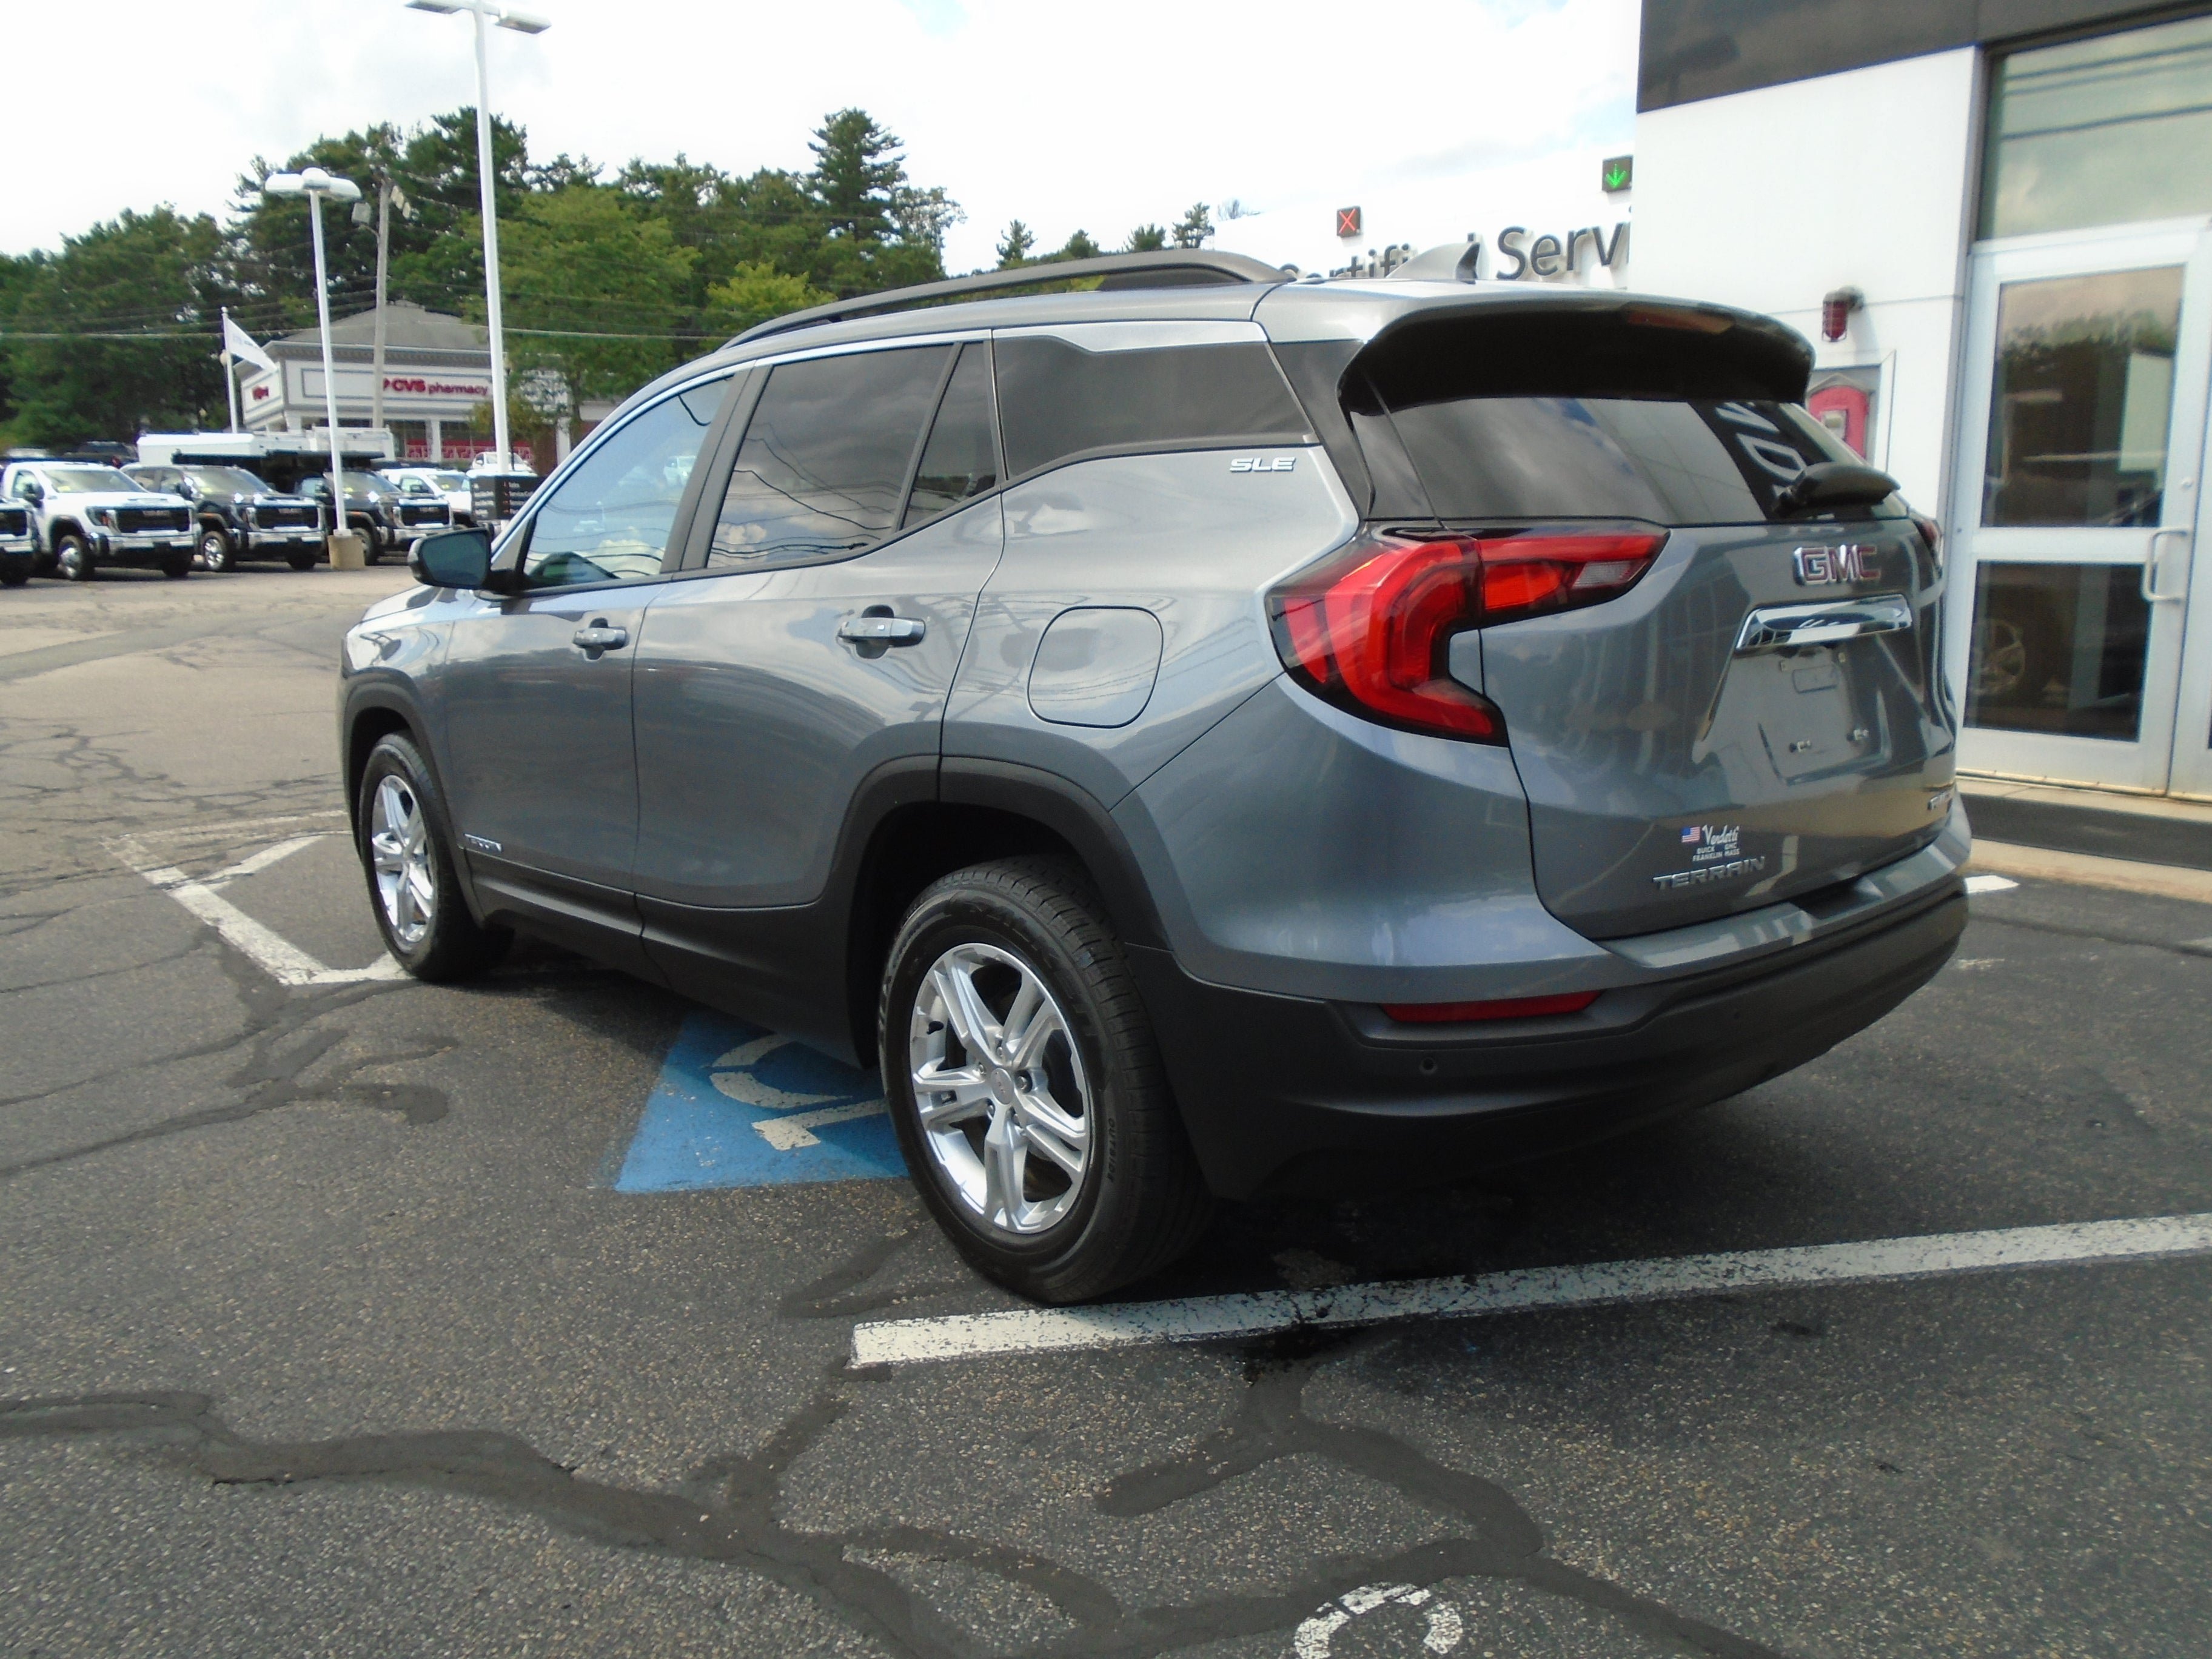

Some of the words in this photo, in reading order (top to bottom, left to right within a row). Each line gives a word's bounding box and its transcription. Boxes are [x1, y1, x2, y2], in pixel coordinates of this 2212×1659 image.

[1496, 206, 1632, 280] Serv
[392, 378, 426, 392] CVS
[428, 382, 488, 395] pharmacy
[1230, 457, 1296, 472] SLE
[1793, 545, 1881, 586] GMC
[1692, 851, 1723, 861] FRANKLIN
[1652, 856, 1765, 890] TERRAIN
